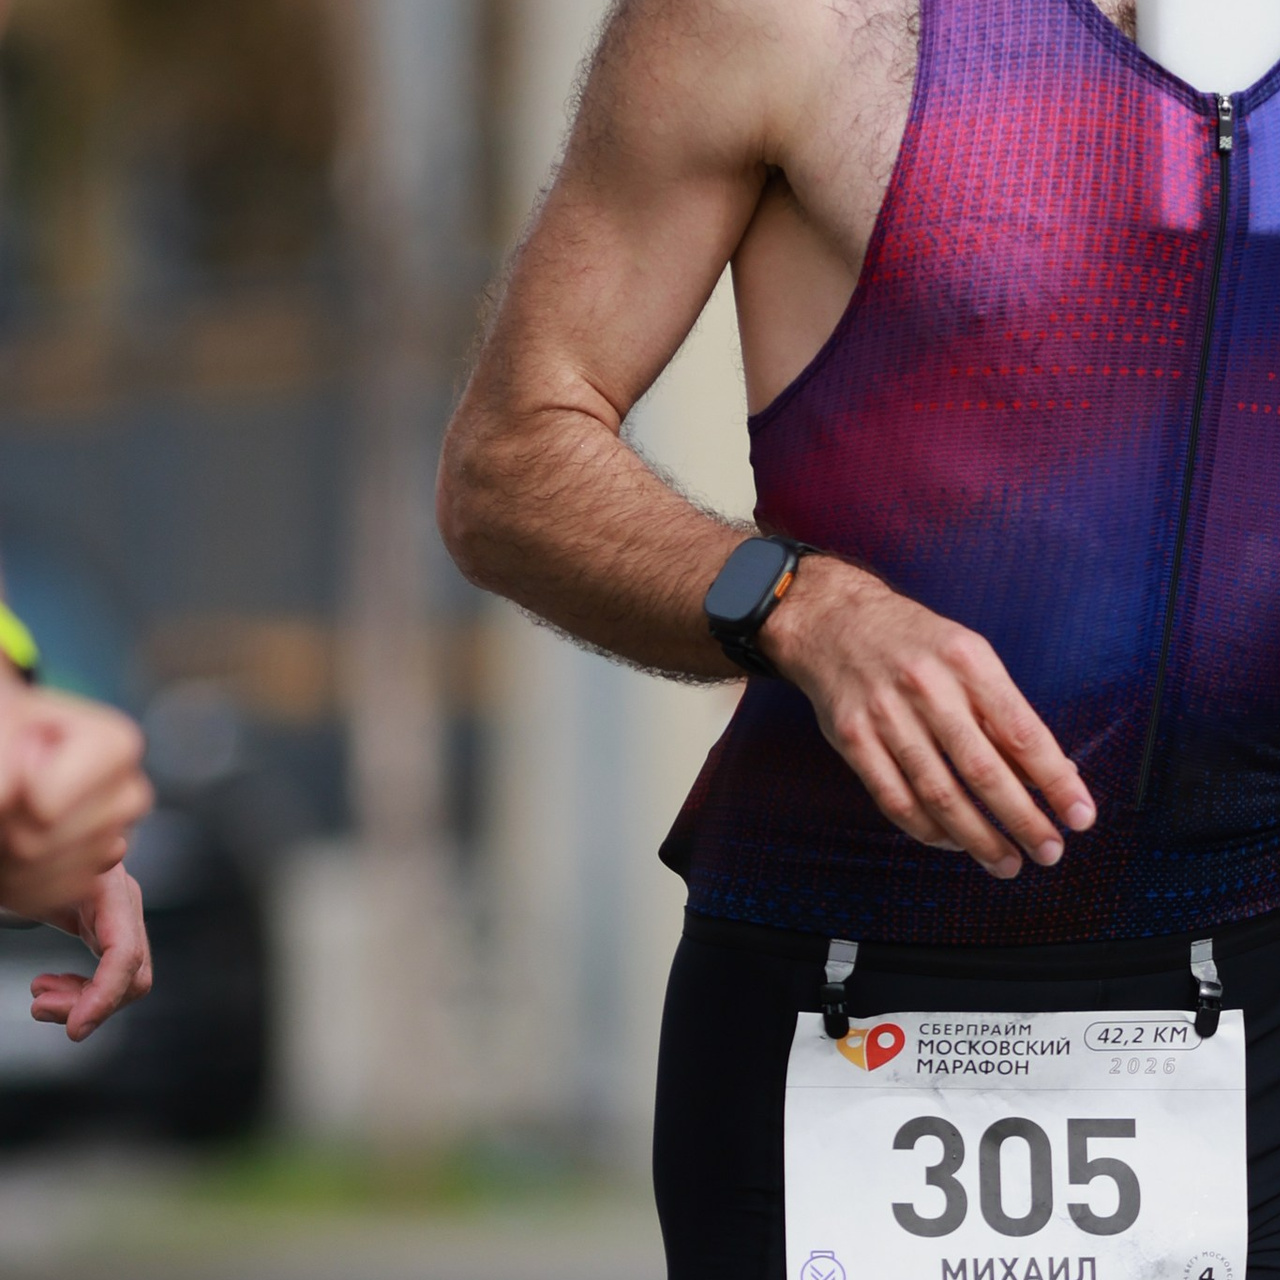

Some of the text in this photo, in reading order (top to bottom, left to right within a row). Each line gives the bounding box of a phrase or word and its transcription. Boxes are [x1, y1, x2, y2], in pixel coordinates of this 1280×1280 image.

[919, 1022, 1032, 1036] СБЕРПРАЙМ
[1097, 1027, 1145, 1047] 42,2
[917, 1037, 1071, 1056] МОСКОВСКИЙ
[916, 1058, 1030, 1075] МАРАФОН
[1108, 1057, 1177, 1075] 2026
[891, 1115, 1141, 1238] 305
